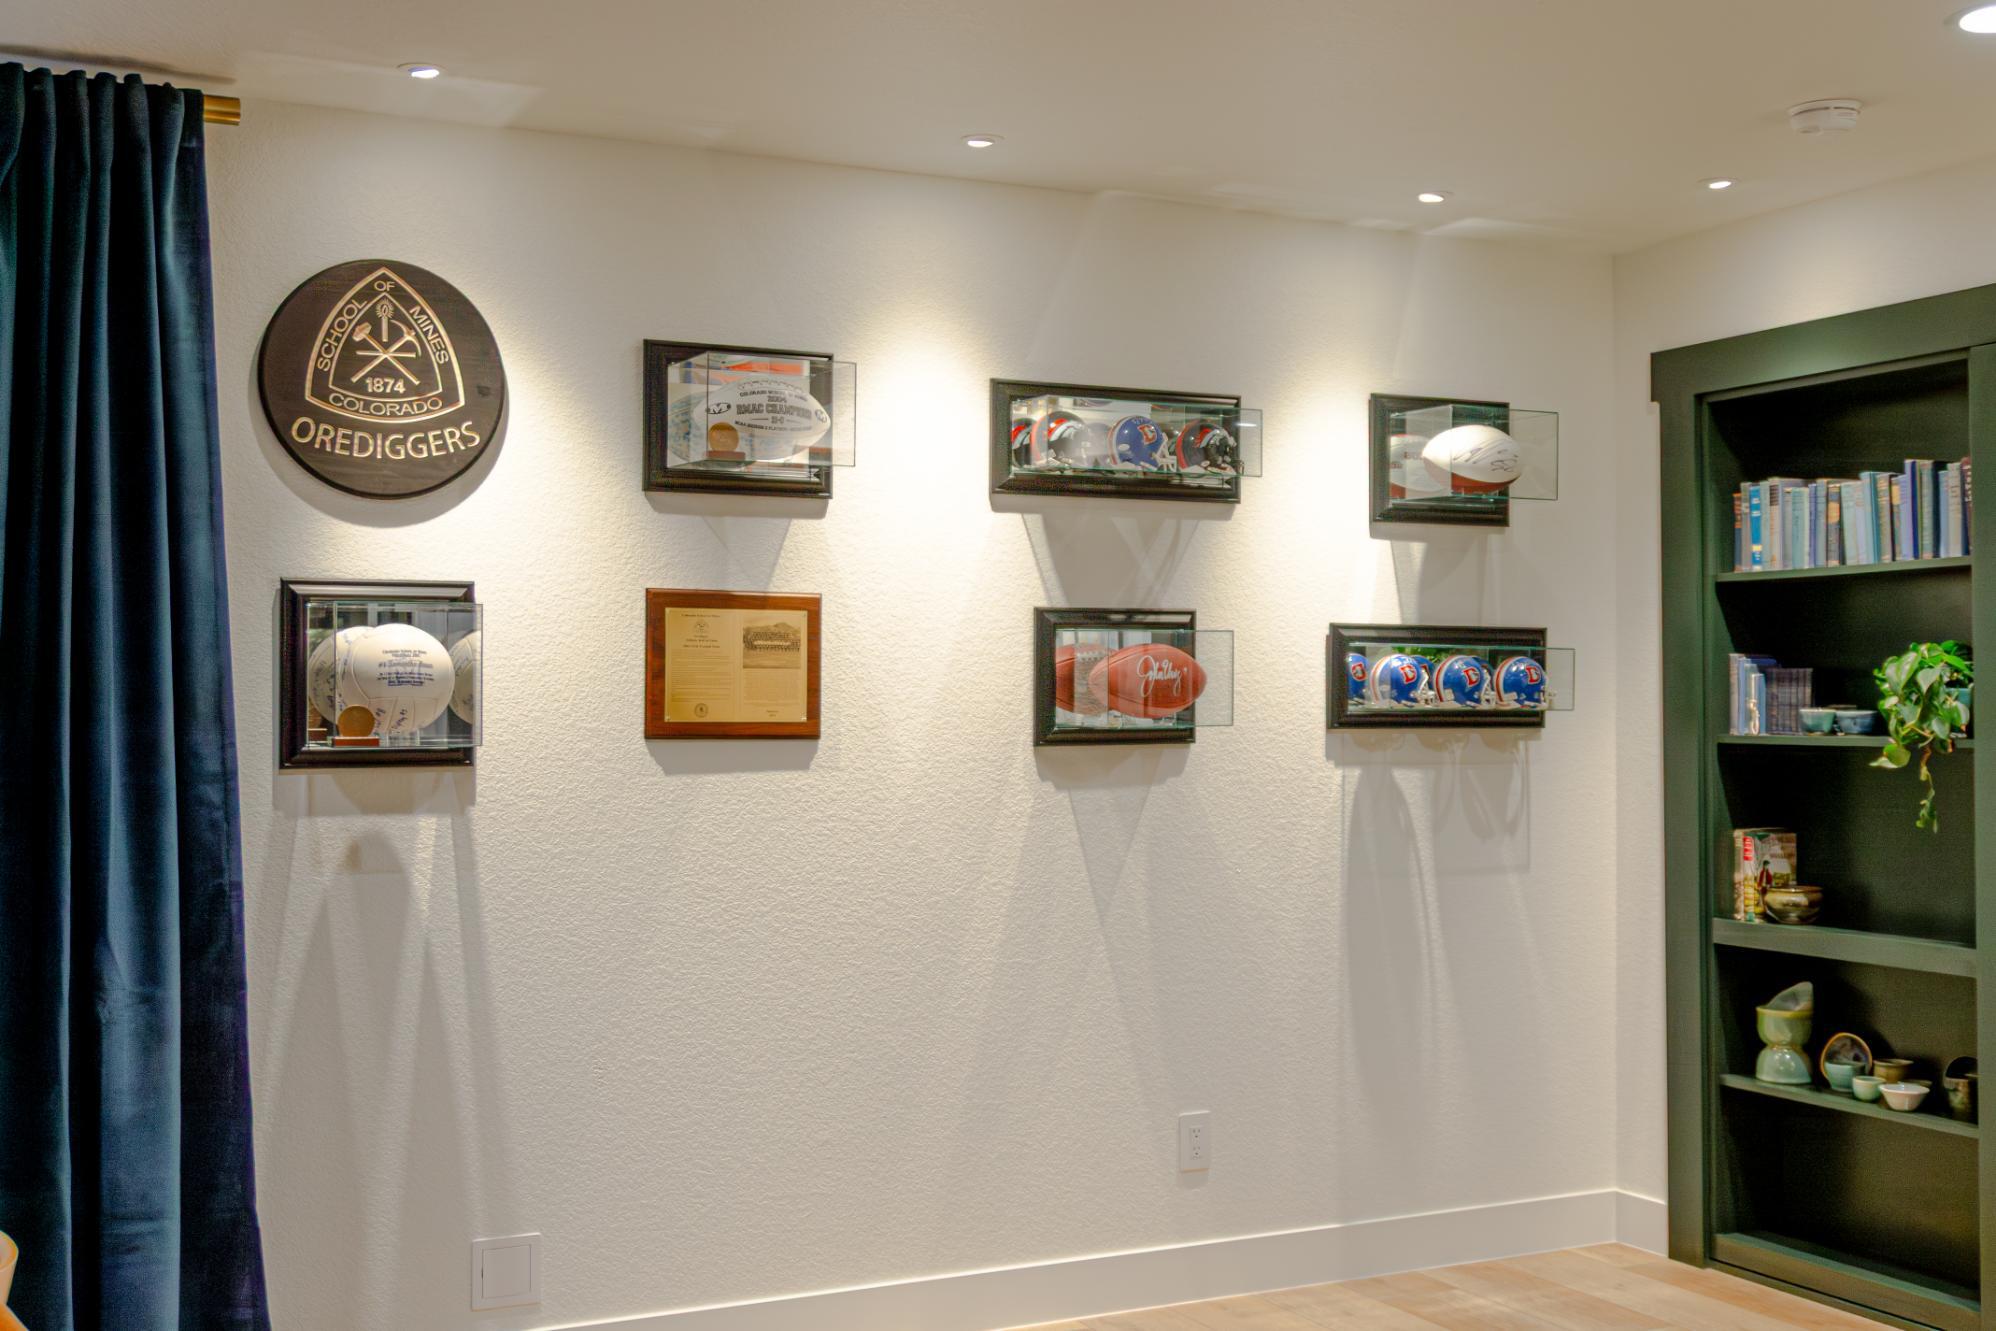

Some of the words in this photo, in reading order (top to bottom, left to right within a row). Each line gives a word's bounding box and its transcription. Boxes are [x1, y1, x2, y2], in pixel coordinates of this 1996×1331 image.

[317, 298, 368, 372] SCHOOL
[374, 281, 395, 291] OF
[409, 305, 449, 365] MINES
[365, 376, 406, 394] 1874
[329, 393, 442, 416] COLORADO
[291, 416, 480, 459] OREDIGGERS
